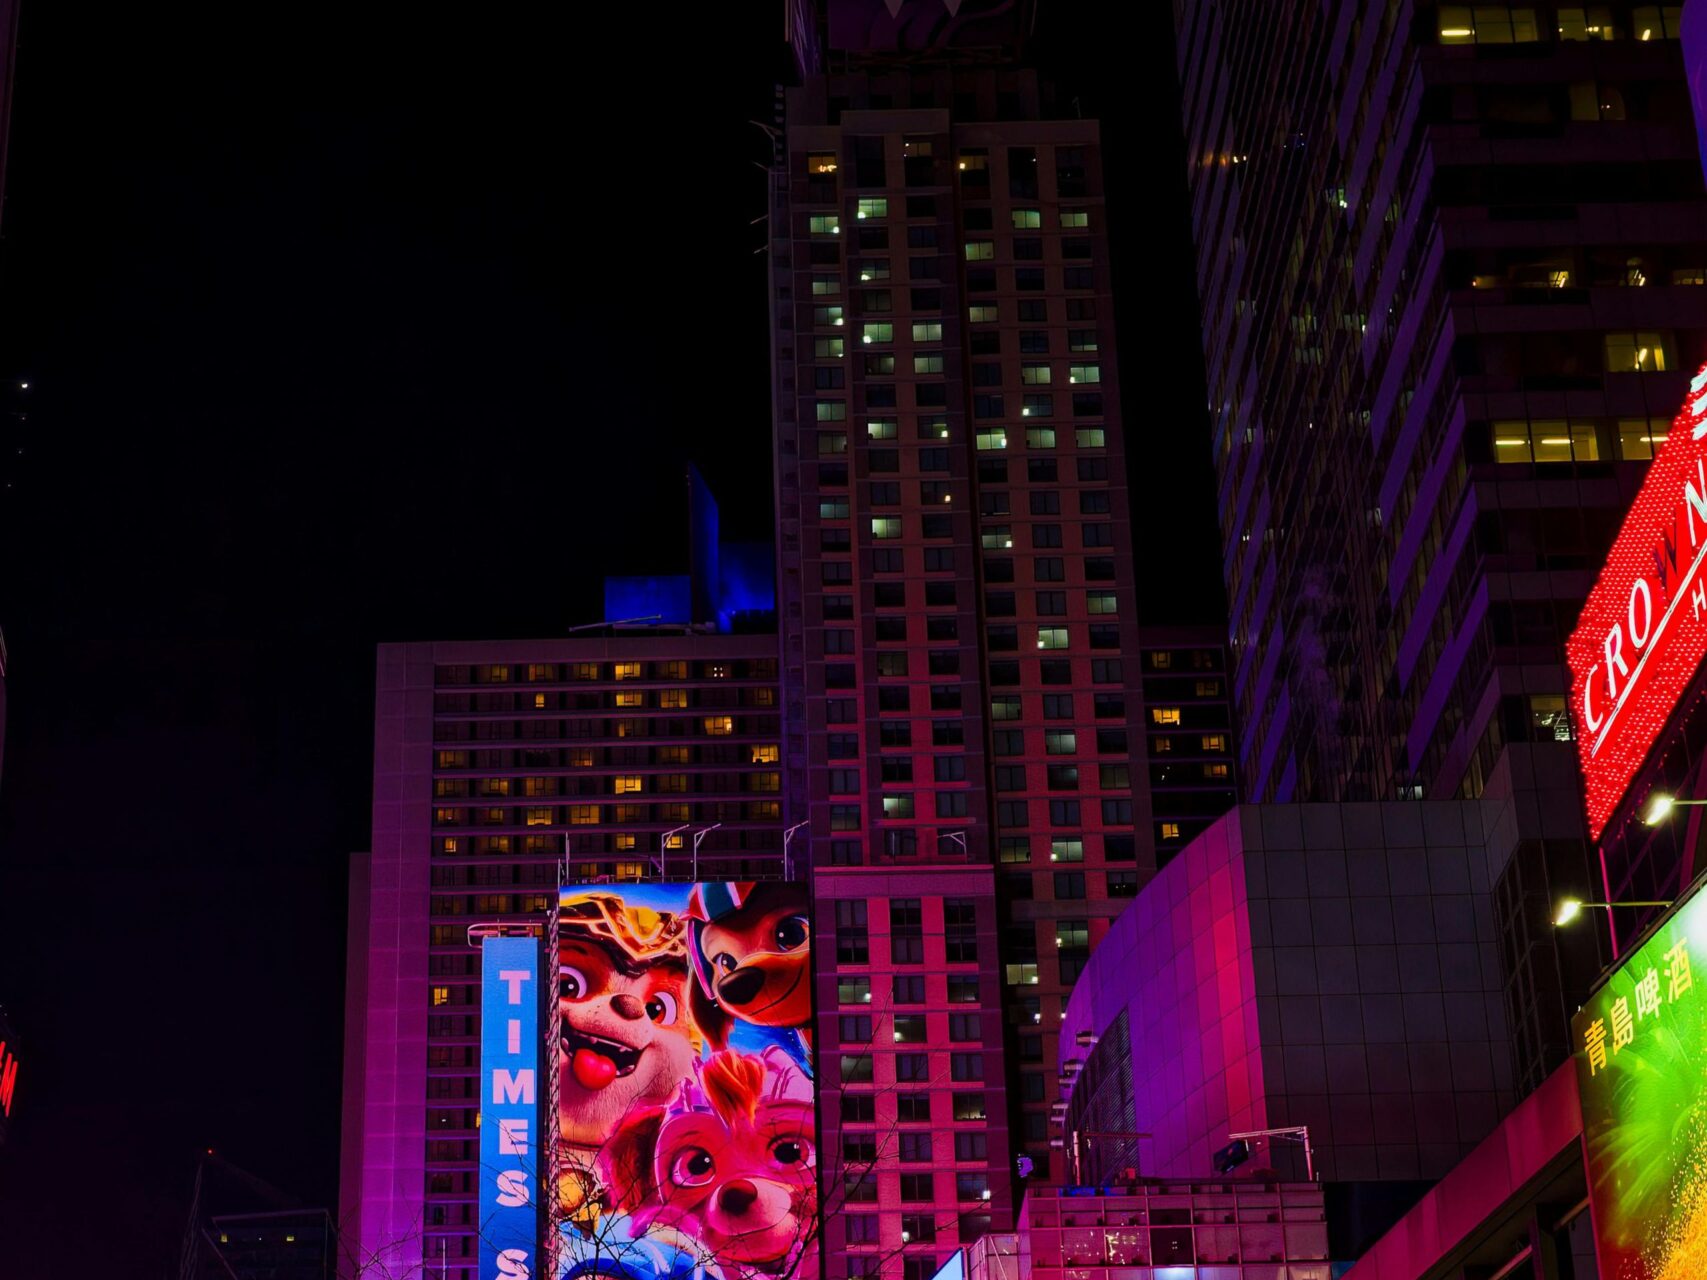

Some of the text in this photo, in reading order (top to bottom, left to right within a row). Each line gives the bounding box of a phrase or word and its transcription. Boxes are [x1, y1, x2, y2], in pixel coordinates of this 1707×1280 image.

[492, 969, 535, 1208] TIMES
[1584, 937, 1692, 1076] 青島啤酒
